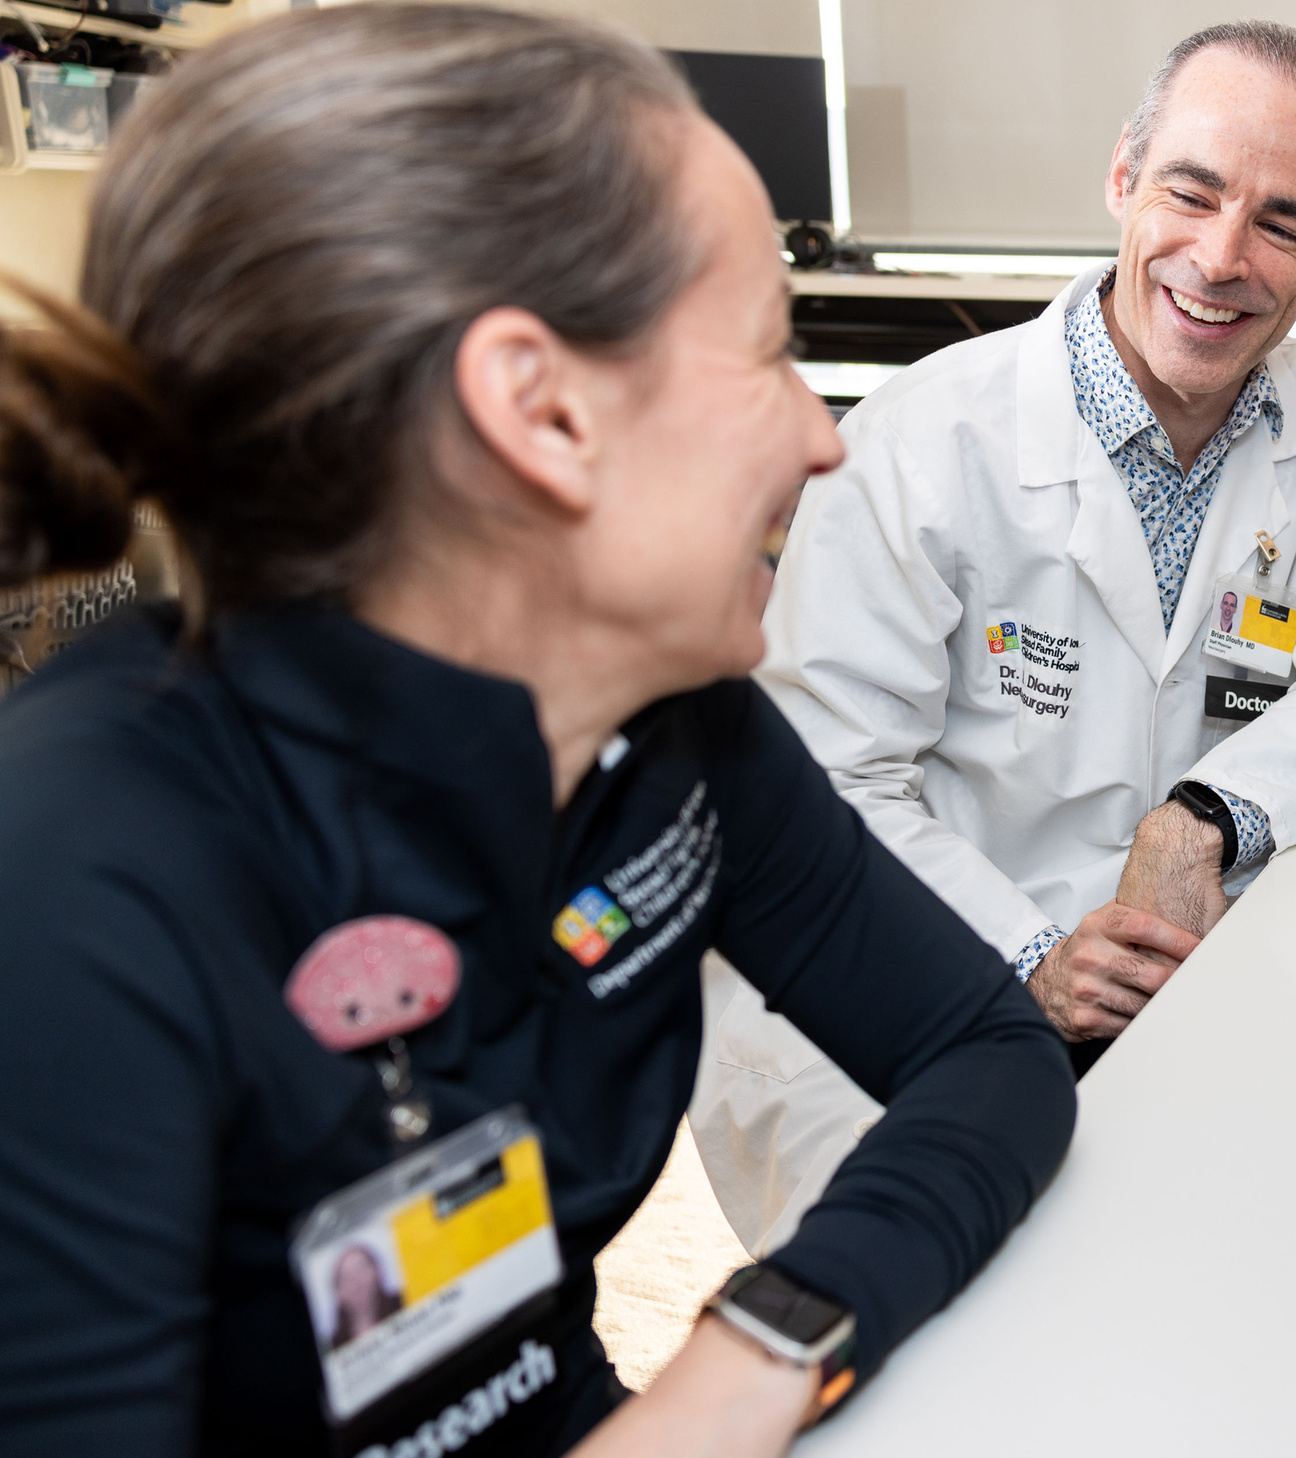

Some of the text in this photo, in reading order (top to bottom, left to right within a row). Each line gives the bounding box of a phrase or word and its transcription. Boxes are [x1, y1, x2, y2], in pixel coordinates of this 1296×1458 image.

[1021, 624, 1056, 647] University
[1056, 637, 1070, 647] of
[1210, 630, 1256, 650] Brian Dlouhy MD
[1036, 642, 1067, 661] Family
[1000, 666, 1020, 680] Dr.
[1027, 674, 1072, 702] Dlouhy
[1225, 691, 1277, 712] Docto
